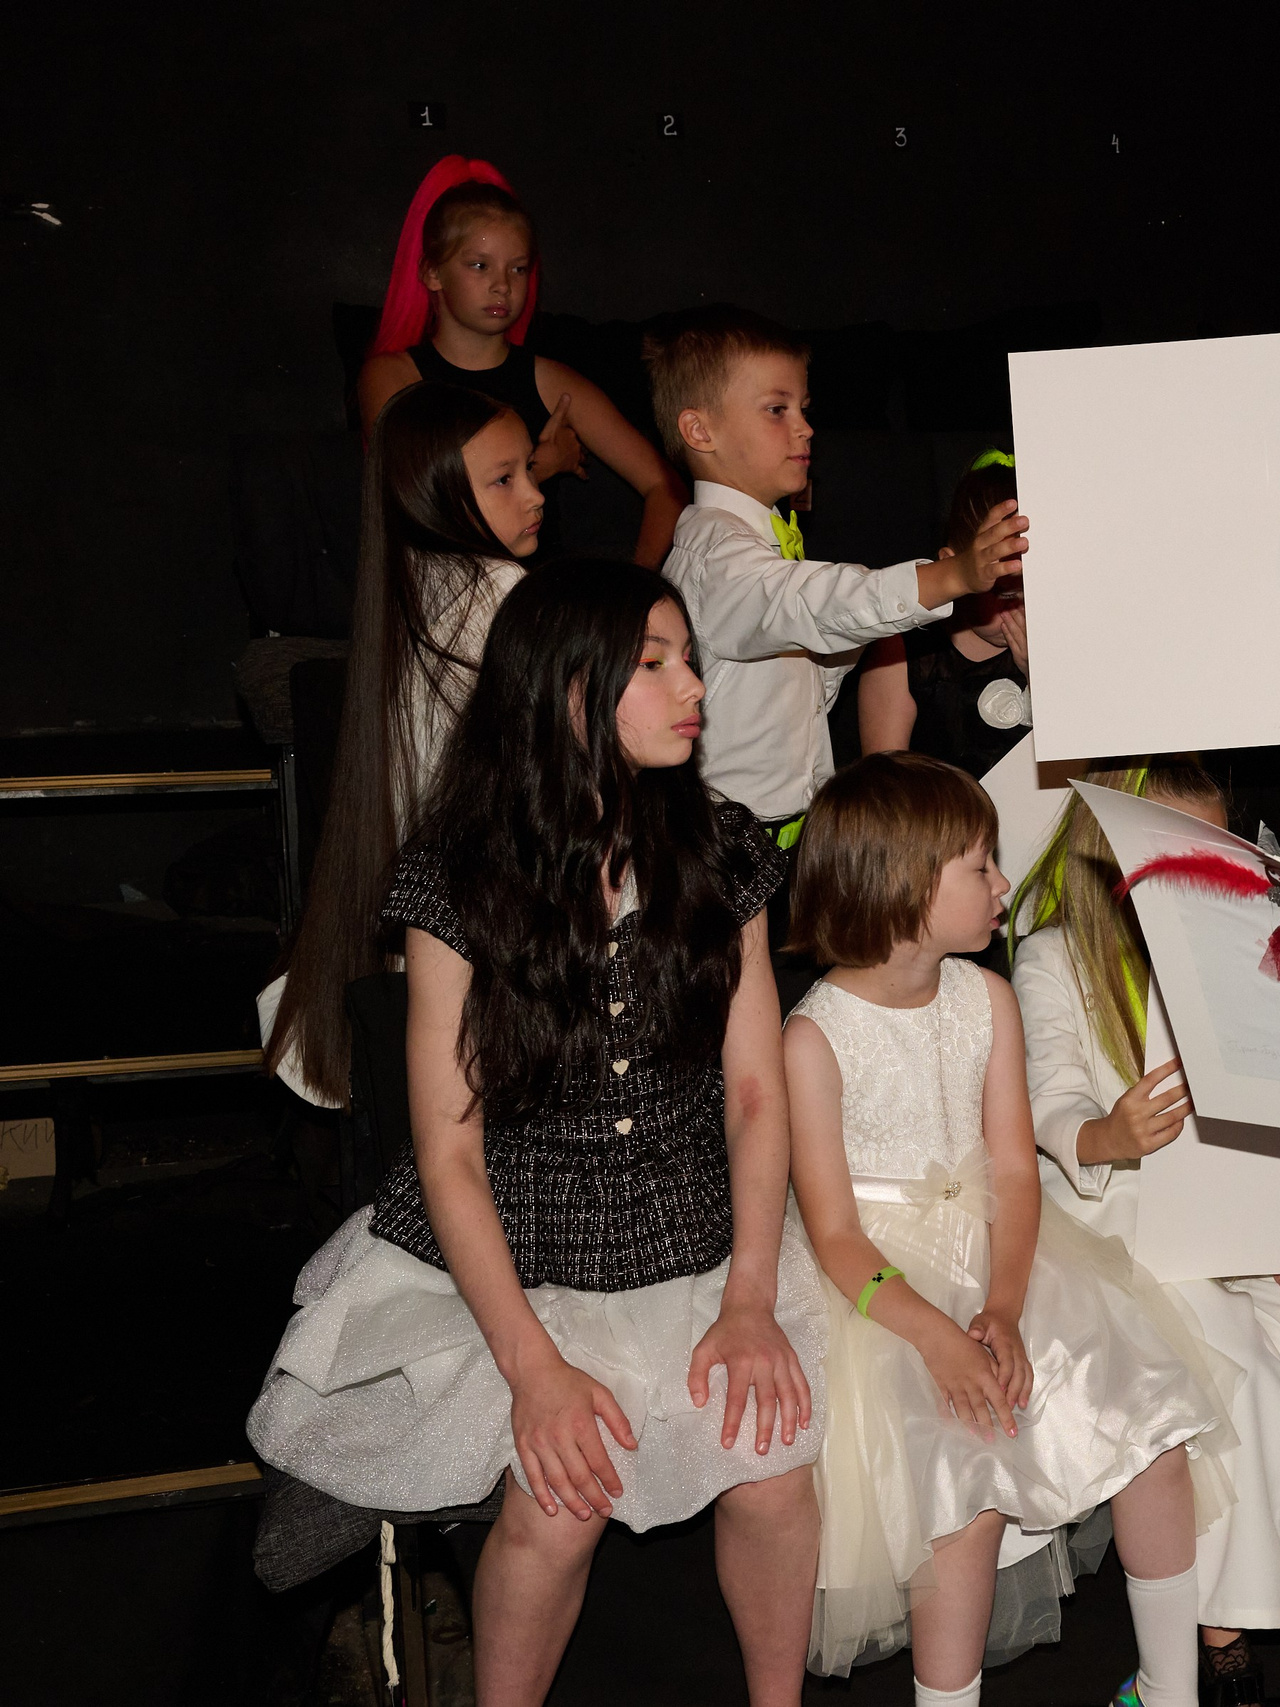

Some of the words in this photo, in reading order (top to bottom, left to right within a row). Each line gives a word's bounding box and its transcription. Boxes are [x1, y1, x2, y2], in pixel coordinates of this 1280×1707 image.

[420, 106, 433, 127] 1
[663, 114, 678, 136] 2
[894, 127, 907, 147] 3
[1111, 133, 1121, 154] 4
